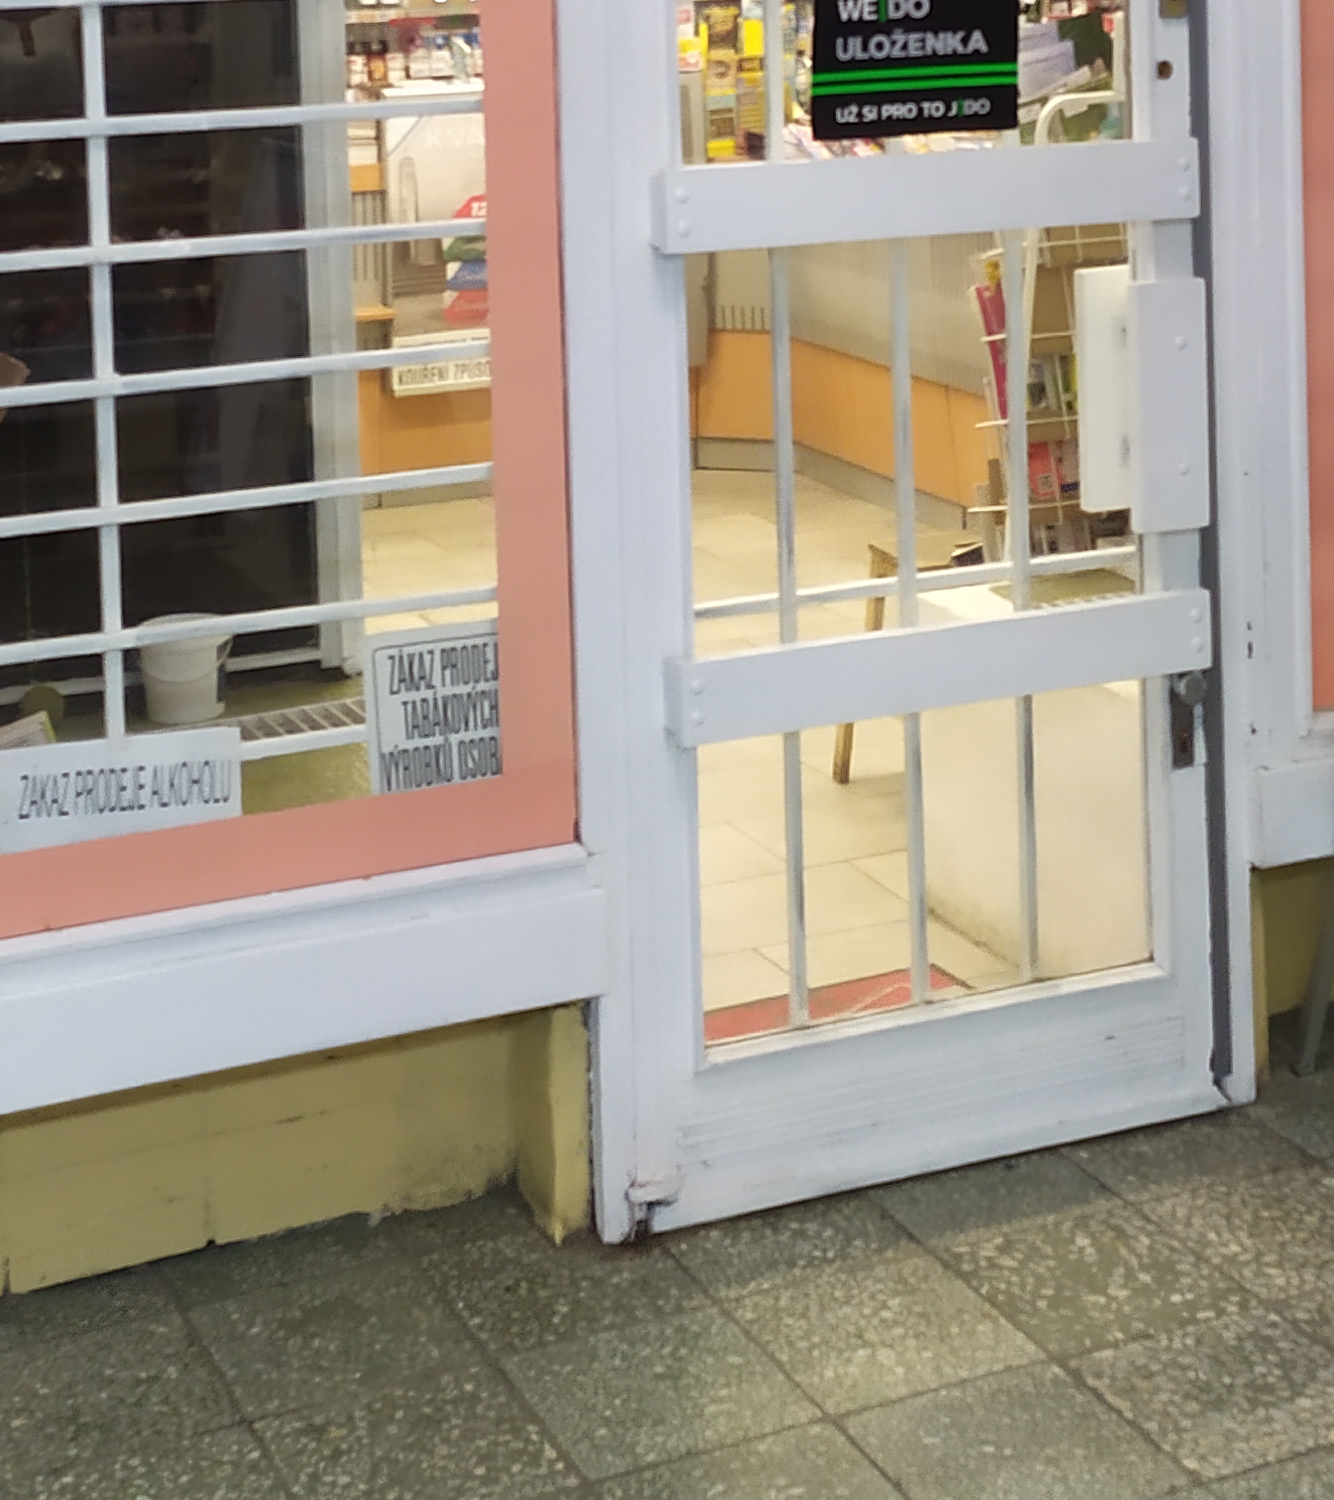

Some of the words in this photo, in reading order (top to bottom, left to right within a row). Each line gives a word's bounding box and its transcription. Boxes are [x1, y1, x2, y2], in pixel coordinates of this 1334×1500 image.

[835, 27, 990, 62] ULOŽENKA
[835, 103, 859, 124] UŽ
[861, 104, 878, 123] SI
[881, 102, 917, 120] PRO
[920, 100, 945, 118] TO
[387, 646, 436, 696] ZÁKAZ
[18, 766, 70, 820] ZÁKAZ
[74, 764, 147, 816] PRODEJE
[150, 758, 232, 809] ALKOHOLU
